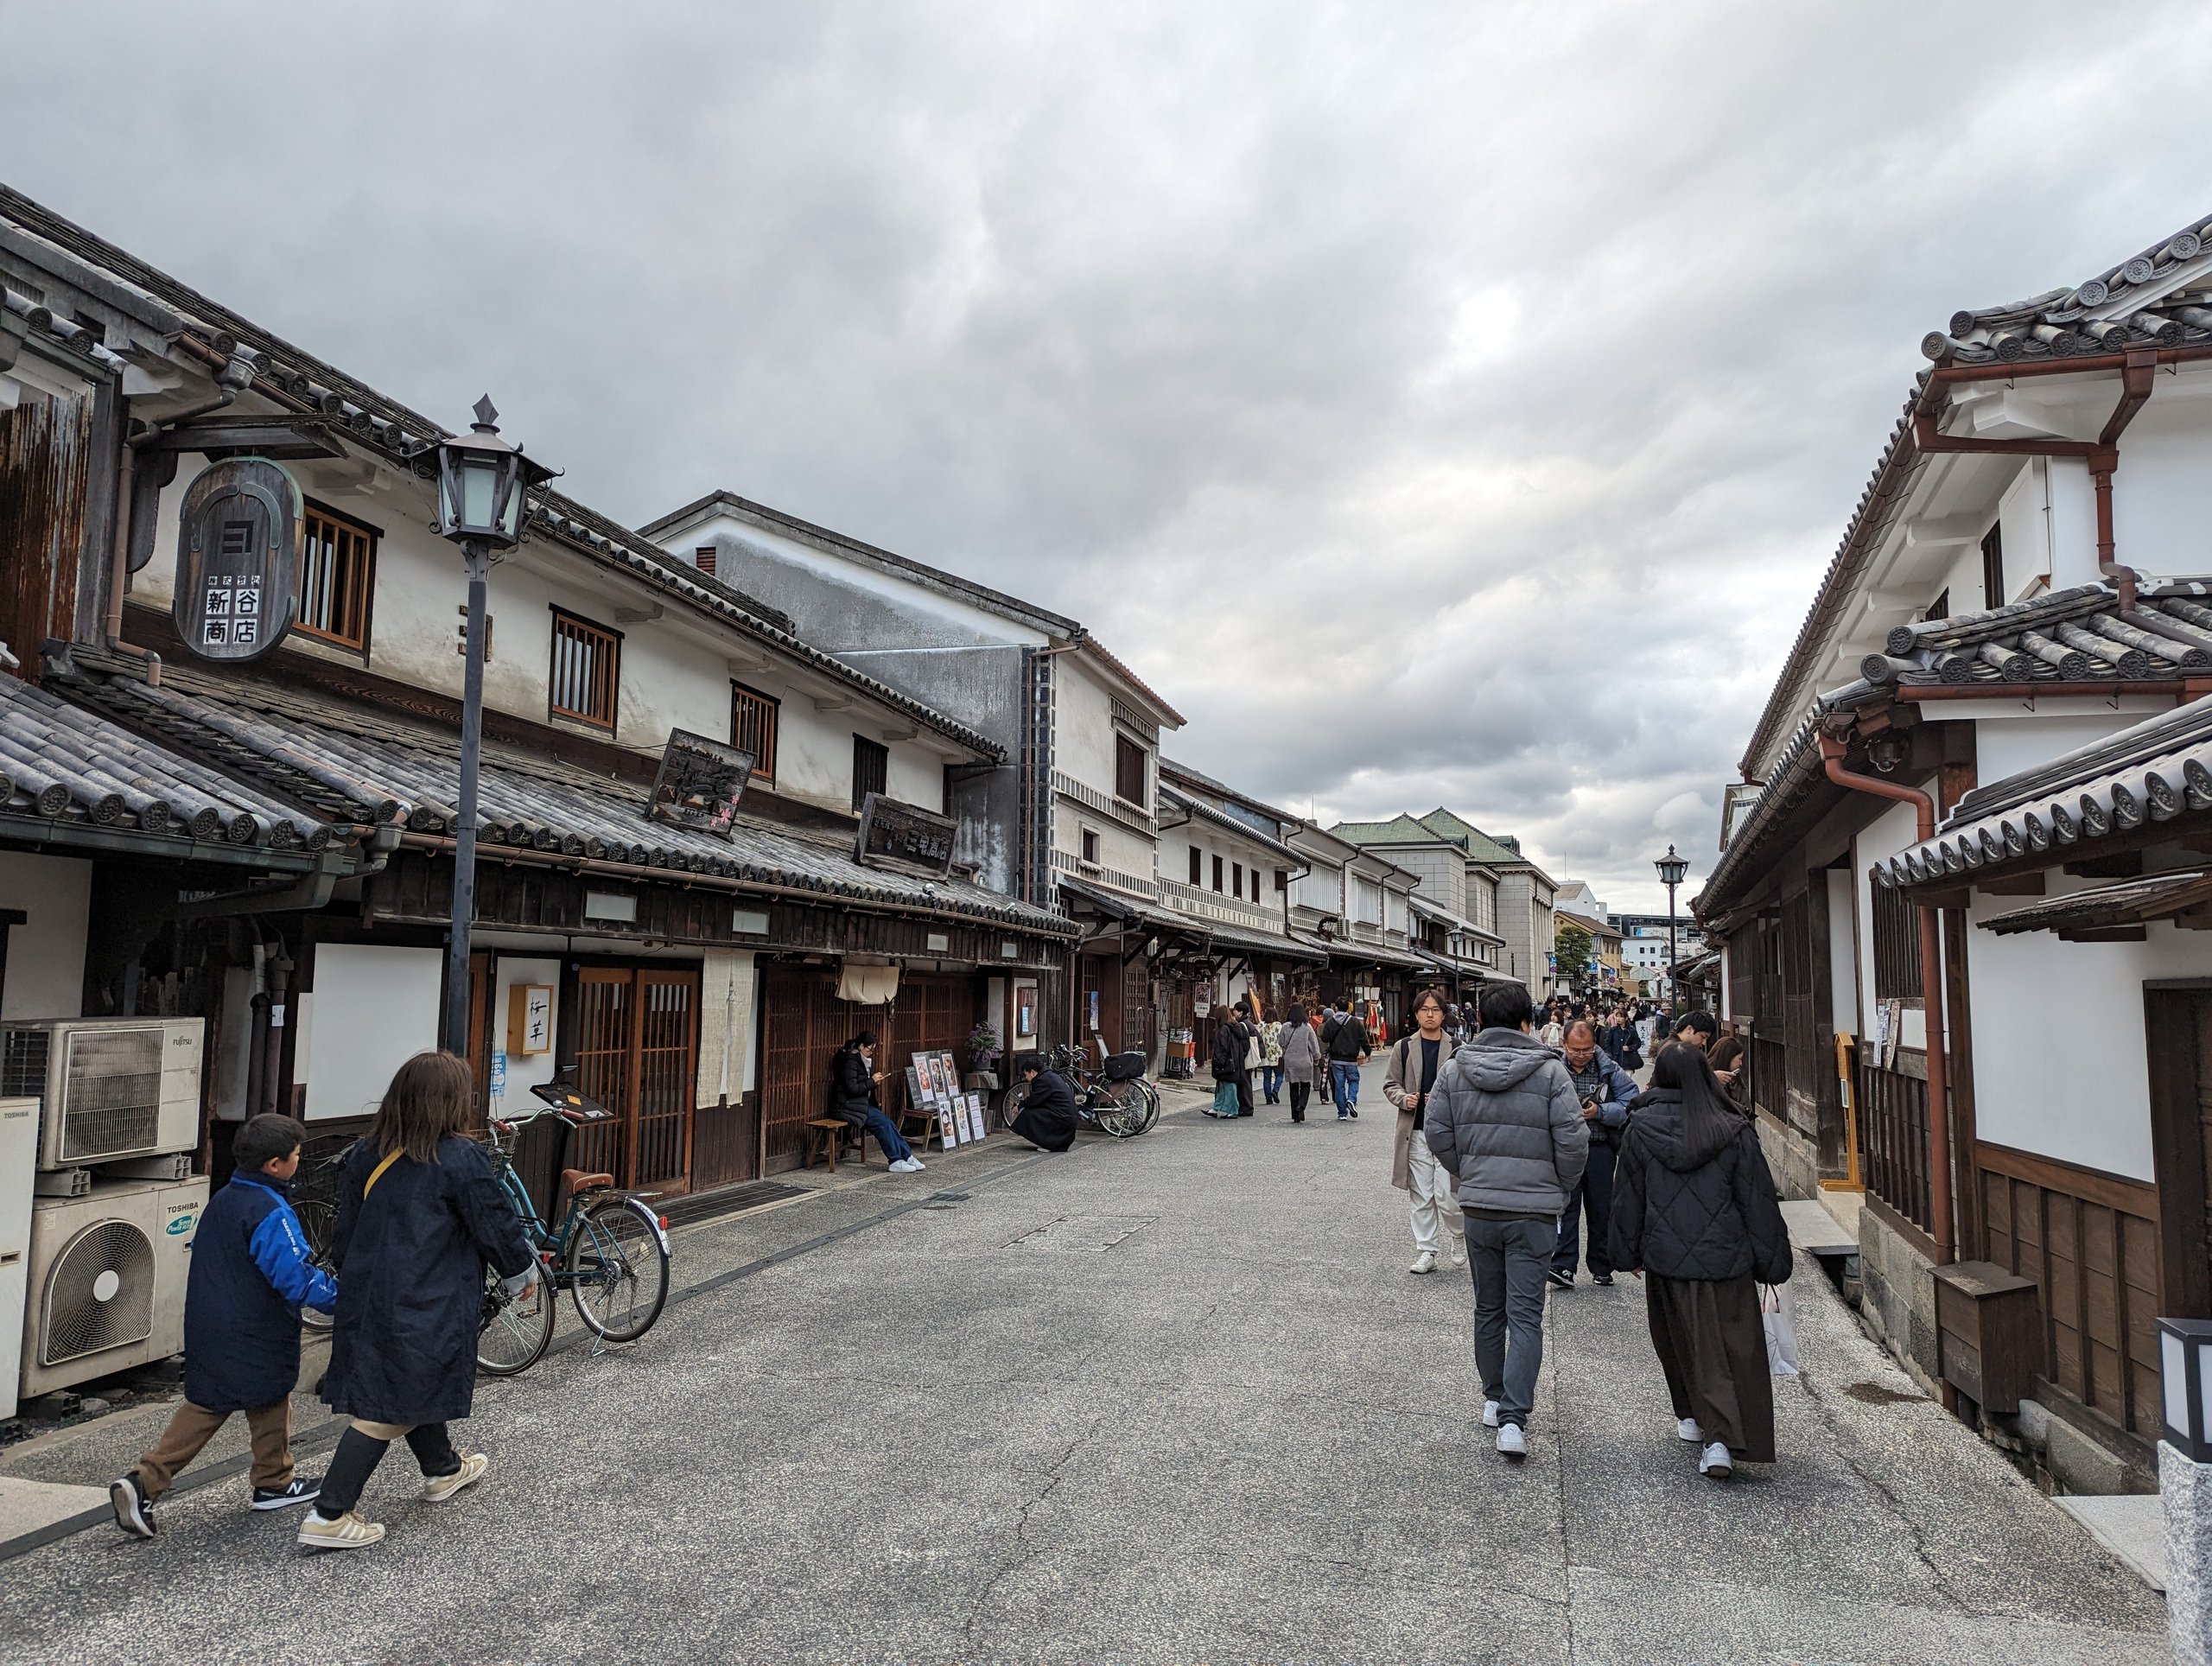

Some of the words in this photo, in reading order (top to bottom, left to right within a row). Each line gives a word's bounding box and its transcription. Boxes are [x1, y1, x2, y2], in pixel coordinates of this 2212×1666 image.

[208, 575, 260, 586] 株式会社
[207, 590, 257, 614] 新谷
[205, 620, 256, 643] 商店
[173, 1035, 193, 1046] FUJITSU
[167, 1202, 199, 1213] TOSHIBA
[286, 1482, 303, 1495] N
